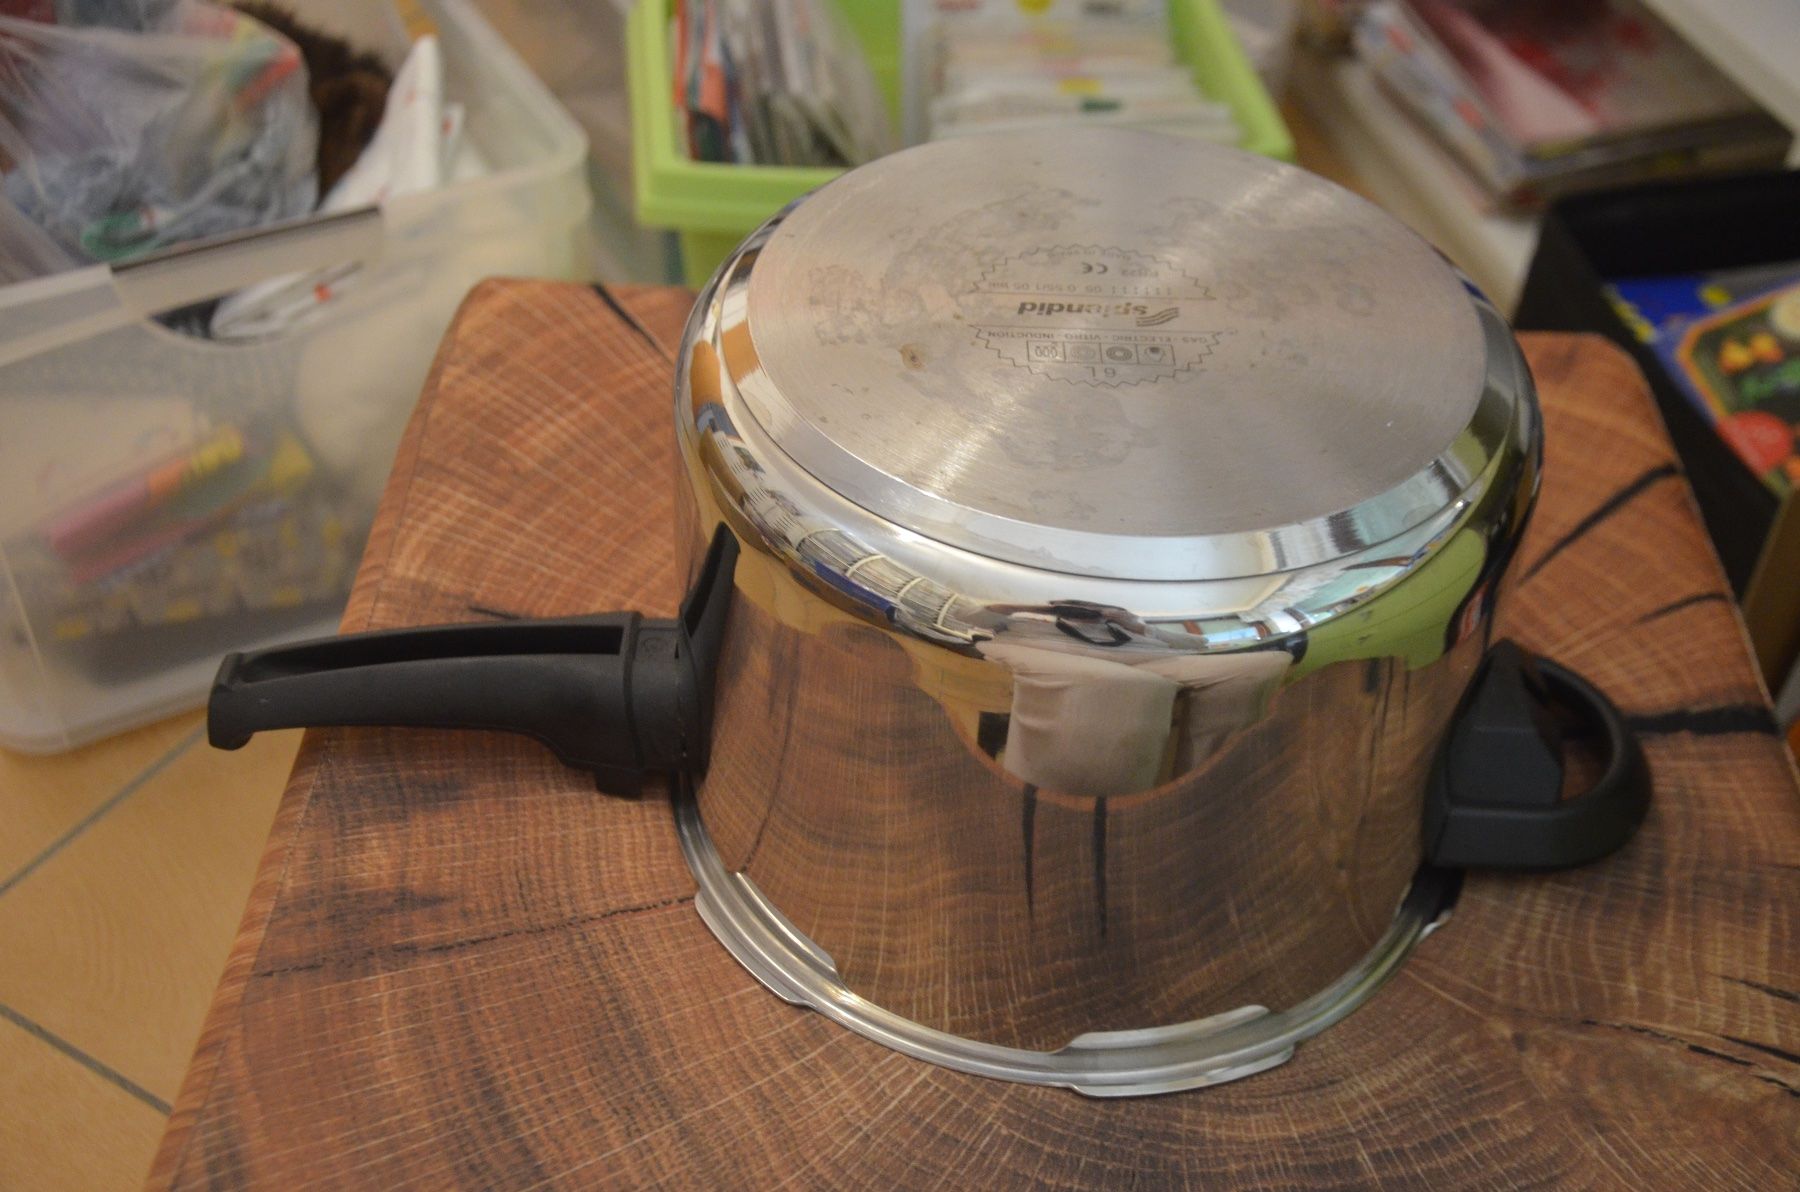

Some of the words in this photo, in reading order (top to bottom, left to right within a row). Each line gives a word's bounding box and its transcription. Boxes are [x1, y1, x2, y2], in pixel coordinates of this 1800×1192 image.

[1082, 262, 1108, 275] CE
[988, 331, 1054, 339] INDUCTION
[1065, 333, 1102, 341] VITRO
[1112, 335, 1172, 343] ELECTRIC
[1085, 366, 1096, 378] L
[1103, 367, 1116, 378] 6
